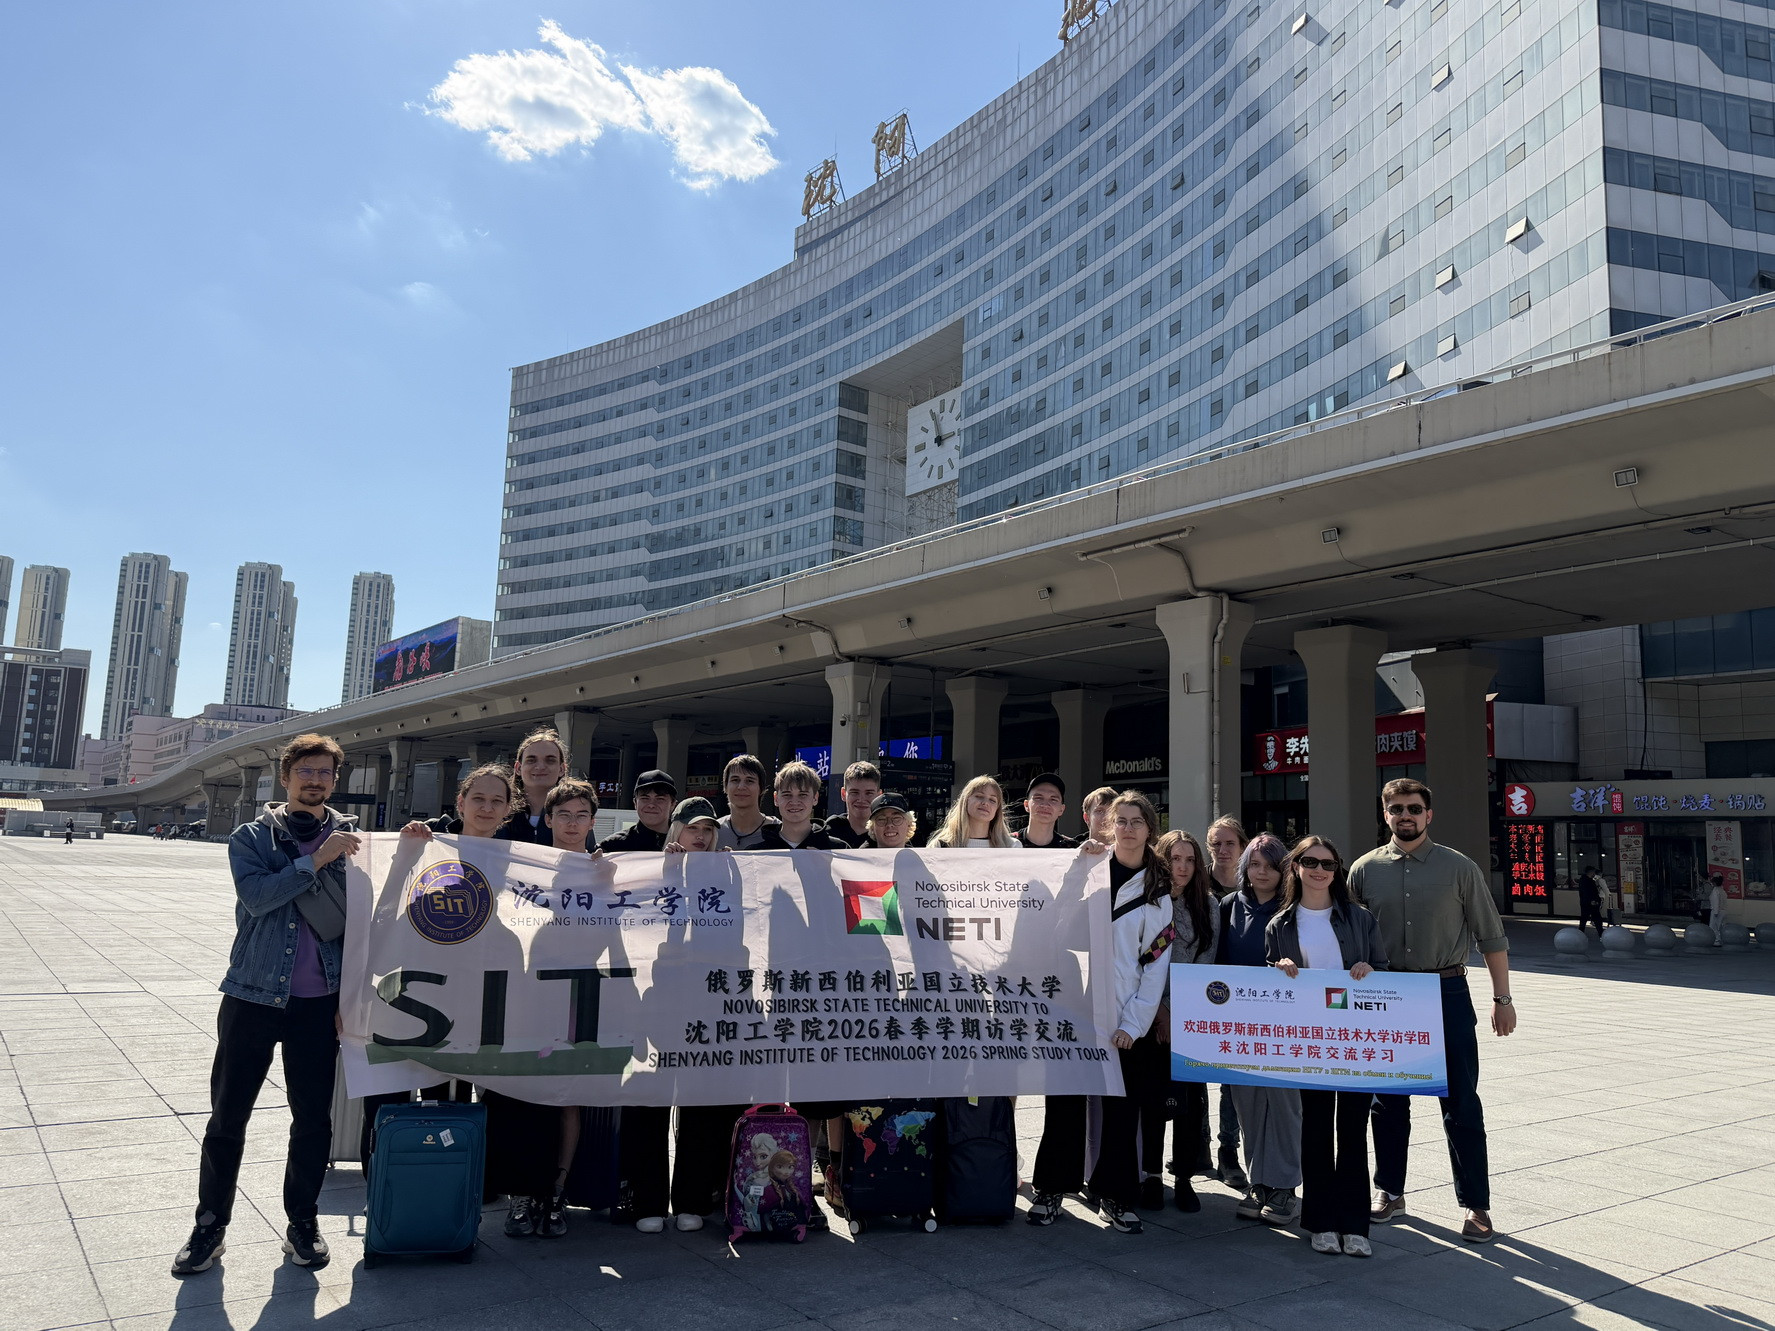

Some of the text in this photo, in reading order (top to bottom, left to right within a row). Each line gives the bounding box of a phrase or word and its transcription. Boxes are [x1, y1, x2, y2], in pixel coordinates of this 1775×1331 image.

[1286, 735, 1309, 756] 李先
[1377, 730, 1417, 753] 肉夹馍
[1106, 757, 1162, 774] McDonald's
[1508, 785, 1528, 815] 吉
[1570, 784, 1616, 814] 吉祥
[1612, 793, 1623, 812] 馄饨
[915, 880, 1030, 892] Novosibirsk State
[1511, 883, 1547, 896] 卤肉饭
[432, 894, 465, 914] SIT
[512, 880, 732, 915] 沈阳工学院
[915, 896, 1045, 912] Technical University
[510, 916, 734, 928] SHENYANG INSTITUTE OF TECHNOLOGY
[916, 917, 1002, 941] NETI
[705, 969, 1062, 998] 俄罗斯新西伯利亚国立技术大学
[1235, 987, 1295, 999] 沈阳工学院
[372, 967, 637, 1047] SIT
[723, 998, 1049, 1015] NOVOSIBIRSK STATE TECHNICAL UNIVERSITY TO
[1354, 1001, 1387, 1011] NETI
[684, 1017, 1078, 1045] 沈阳工学院2026春季学期访学交流
[1183, 1020, 1430, 1045] 欢迎俄罗斯新西伯利亚国立技术大学访学团
[648, 1045, 1110, 1068] SHENYANG INSTITUTE OF TECHNOLOGY 2026 SPRING STUDY TOUR
[1218, 1040, 1395, 1063] 来沈阳工学院交流学习
